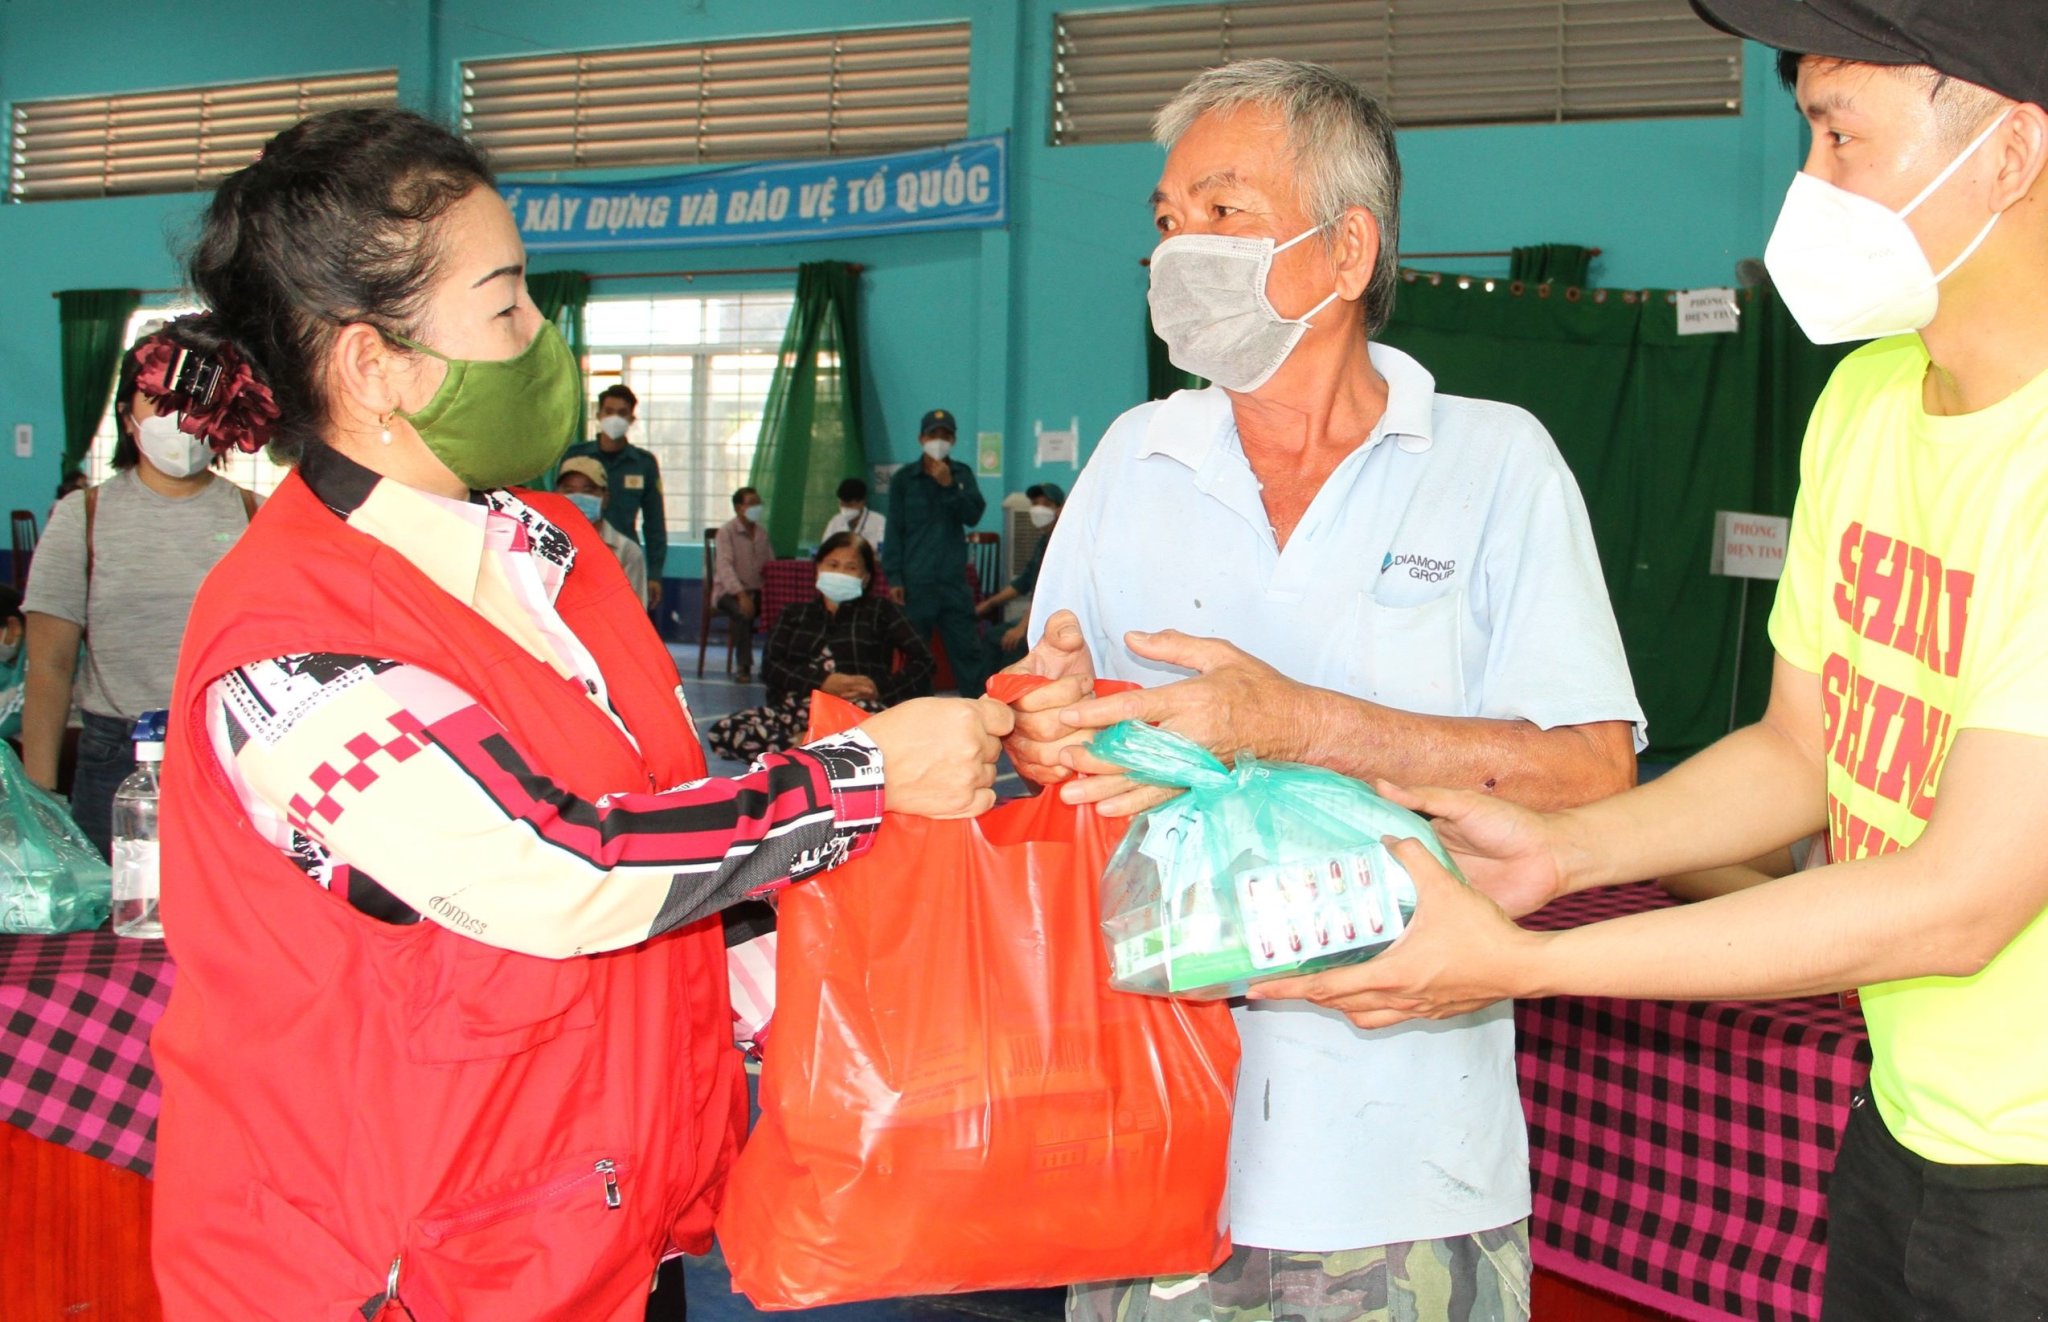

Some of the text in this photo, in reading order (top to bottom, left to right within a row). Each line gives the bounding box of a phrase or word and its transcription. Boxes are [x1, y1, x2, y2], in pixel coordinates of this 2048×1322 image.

[522, 192, 582, 232] XÂY
[585, 192, 671, 236] DỰNG
[678, 188, 718, 226] VÀ
[725, 180, 791, 225] BẢO
[799, 176, 837, 223] VỆ
[896, 154, 990, 214] QUỐC
[1394, 554, 1456, 571] DIAMOND
[1408, 567, 1455, 583] GROUP
